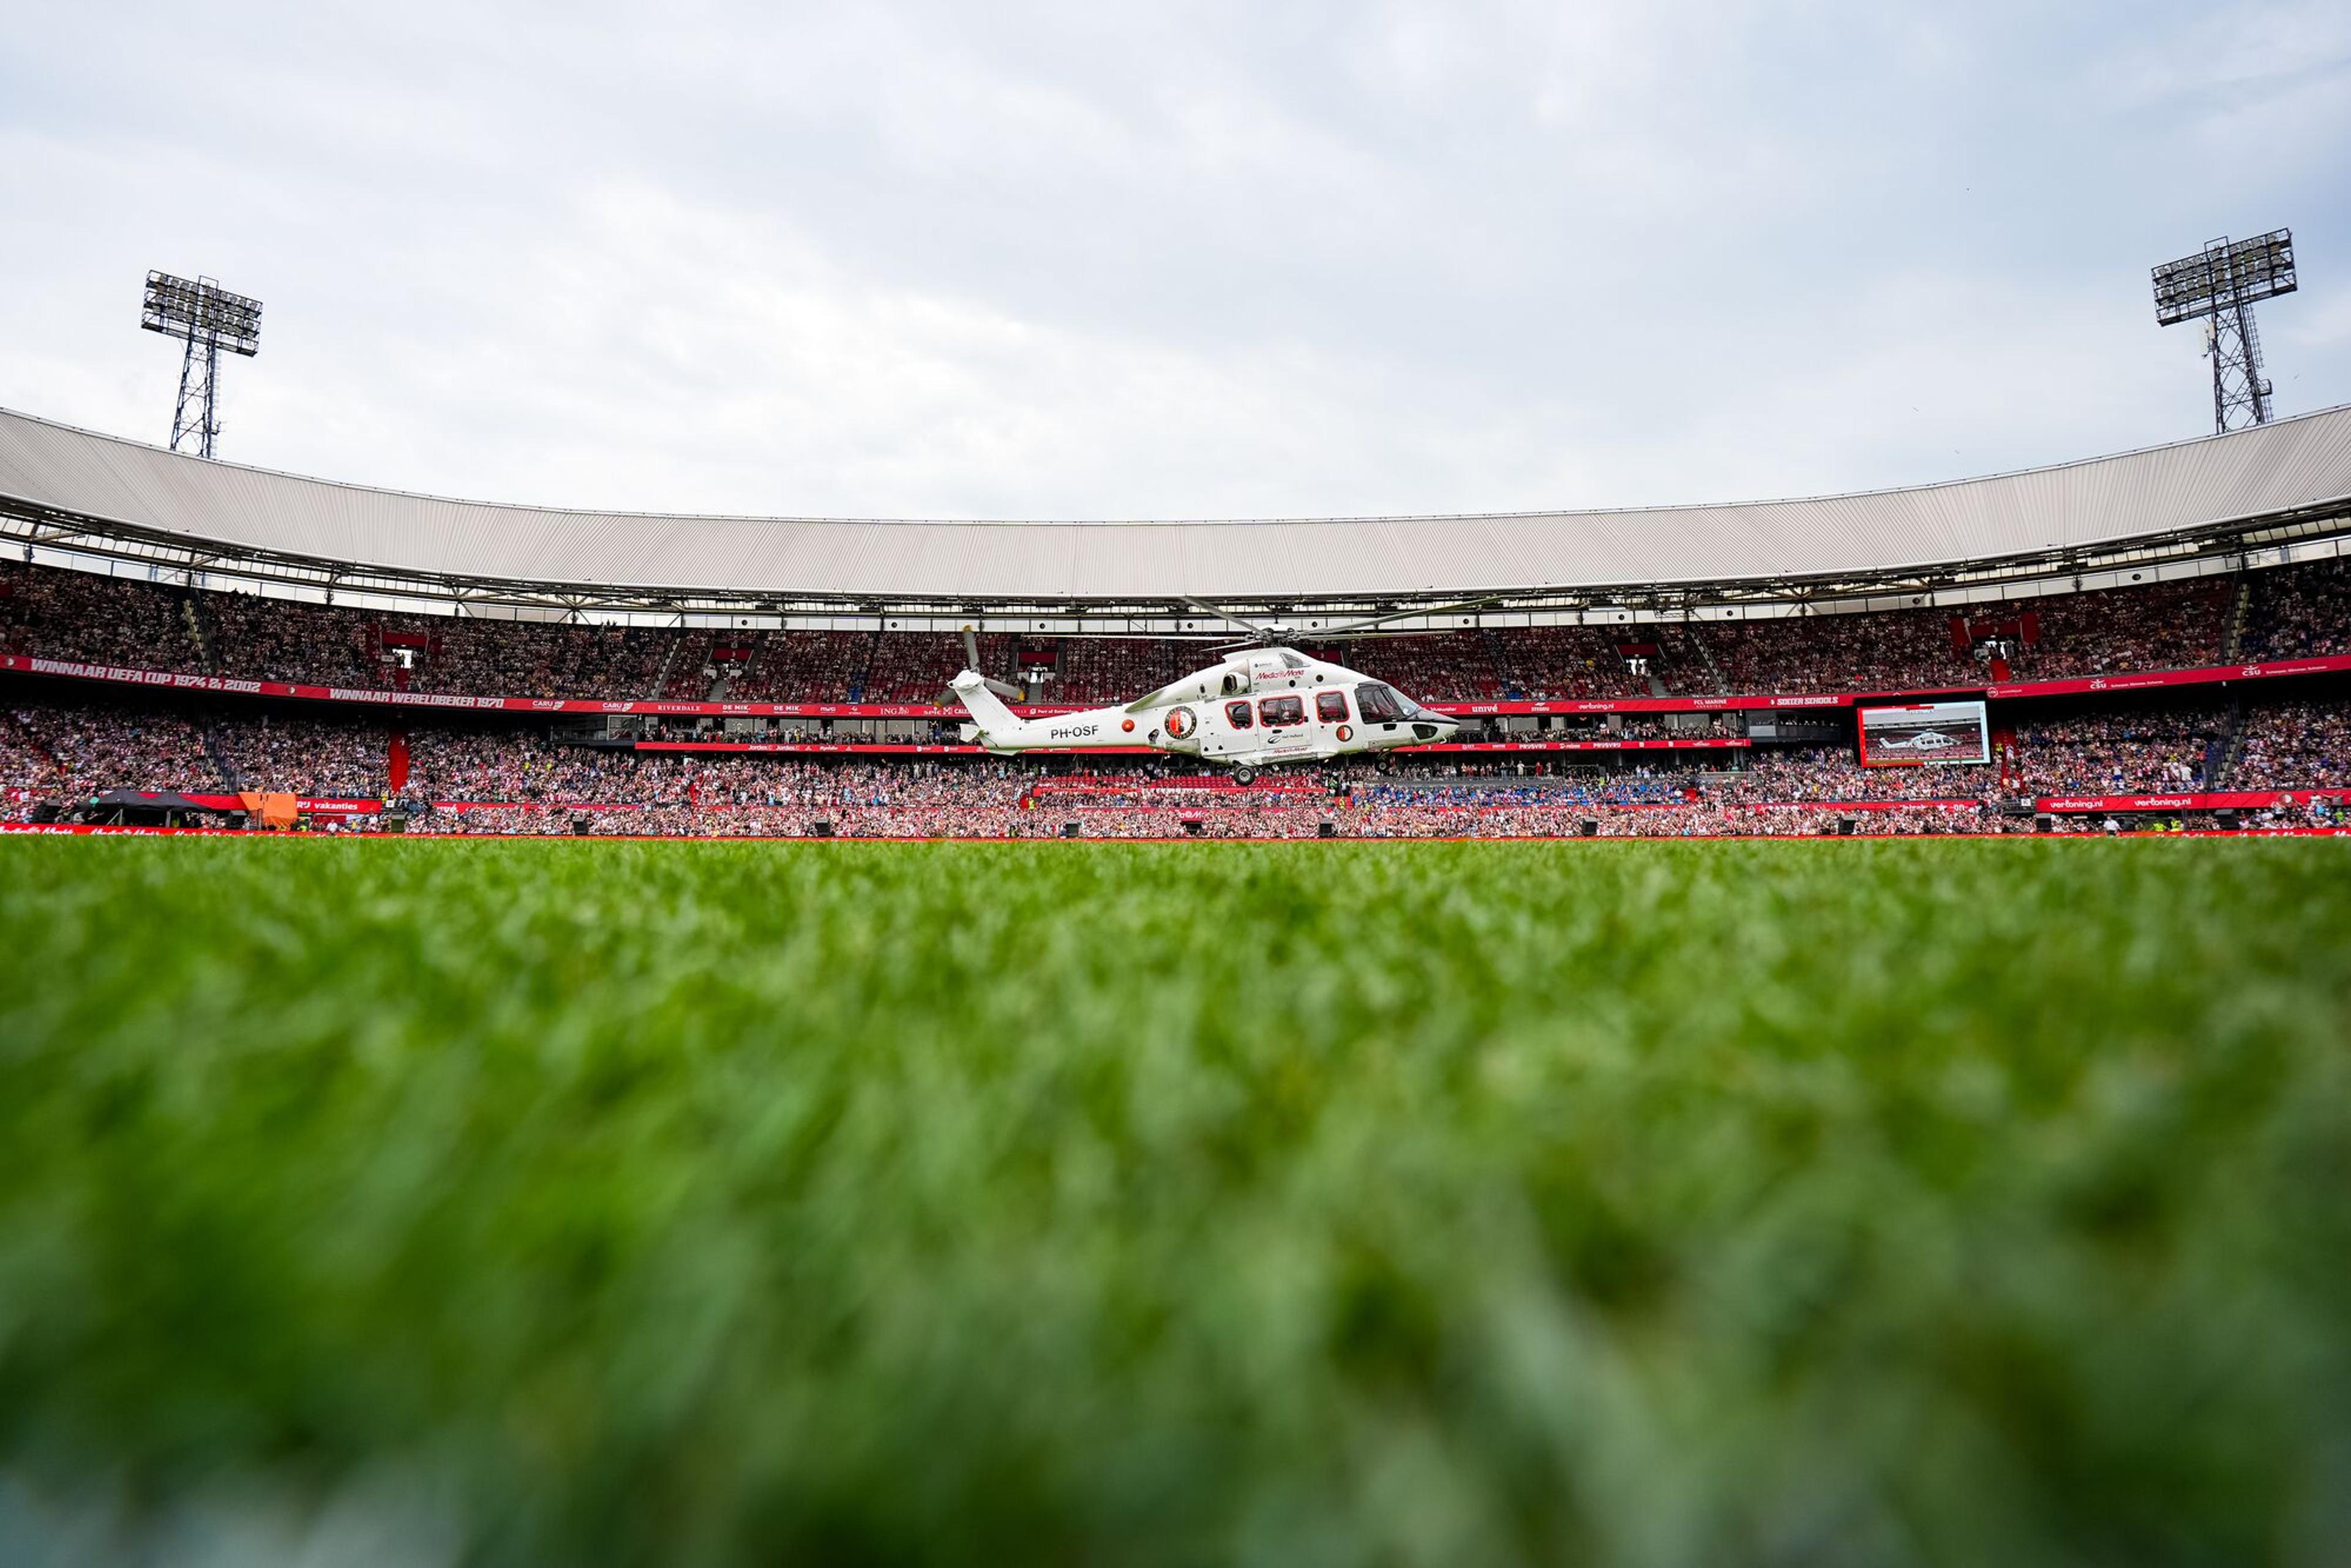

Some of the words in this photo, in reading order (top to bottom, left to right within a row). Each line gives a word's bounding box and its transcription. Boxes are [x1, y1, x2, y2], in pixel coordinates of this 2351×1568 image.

[31, 659, 107, 678] WINNAAR
[107, 668, 143, 682] UEFA
[144, 672, 172, 685] CUP
[174, 675, 207, 688] 1974
[208, 678, 222, 689] &
[224, 680, 261, 693] 2002
[330, 688, 390, 702] WINNAAR
[392, 692, 474, 707] WERELDBEKER
[477, 697, 504, 708] 1970
[1472, 704, 1498, 713] univé
[1051, 725, 1098, 739] PH-OSF
